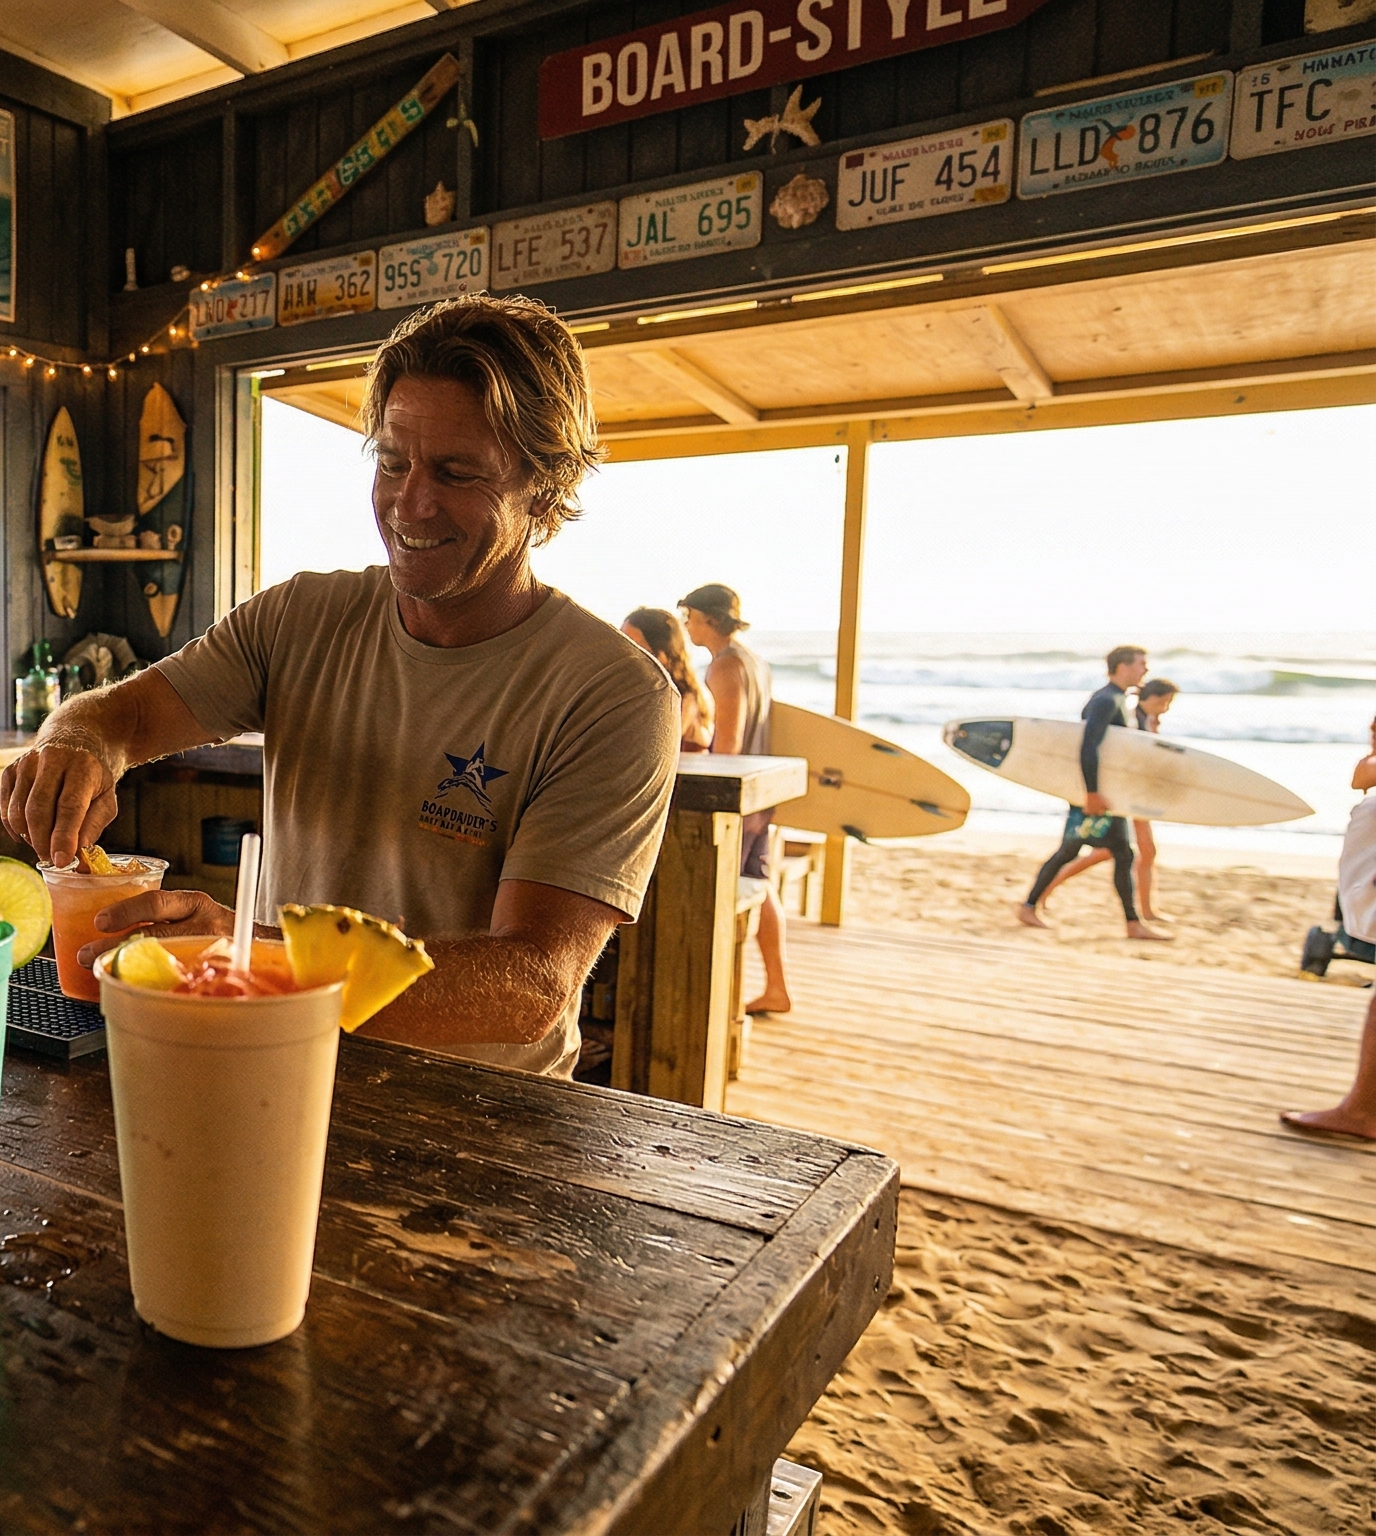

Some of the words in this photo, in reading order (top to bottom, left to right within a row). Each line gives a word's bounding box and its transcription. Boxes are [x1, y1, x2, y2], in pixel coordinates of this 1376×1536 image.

[1250, 78, 1333, 133] TFC
[1029, 125, 1101, 176] LLD
[1138, 101, 1215, 154] 876
[848, 162, 910, 208] JUF
[935, 145, 1001, 191] 454
[498, 234, 542, 272] LFE
[561, 222, 608, 261] 537
[627, 211, 676, 248] JAL
[698, 195, 752, 236] 695
[335, 269, 370, 301] 362
[442, 247, 482, 282] 720
